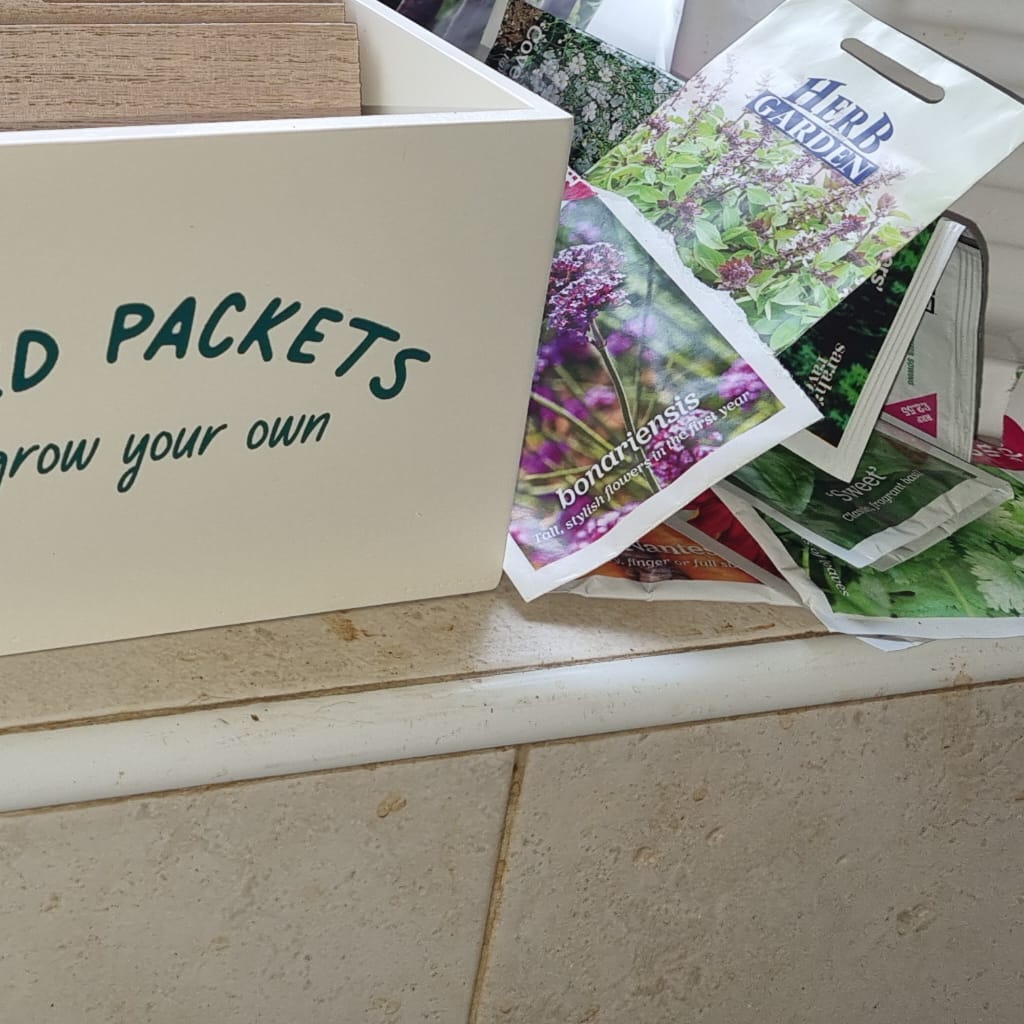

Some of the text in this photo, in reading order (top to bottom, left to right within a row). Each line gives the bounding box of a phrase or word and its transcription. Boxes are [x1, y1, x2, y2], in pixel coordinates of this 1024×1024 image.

[508, 25, 542, 79] Cove
[753, 95, 877, 183] GARDEN
[782, 78, 894, 154] HERB
[106, 292, 431, 400] PACKETS
[117, 423, 228, 493] your
[246, 412, 331, 449] own
[555, 392, 701, 509] bonariensis
[566, 495, 604, 530] stylish
[601, 458, 651, 503] flowers
[652, 447, 666, 463] in
[666, 429, 689, 449] the
[689, 413, 718, 443] first
[720, 390, 751, 419] year
[627, 558, 670, 570] finger
[694, 559, 717, 568] full
